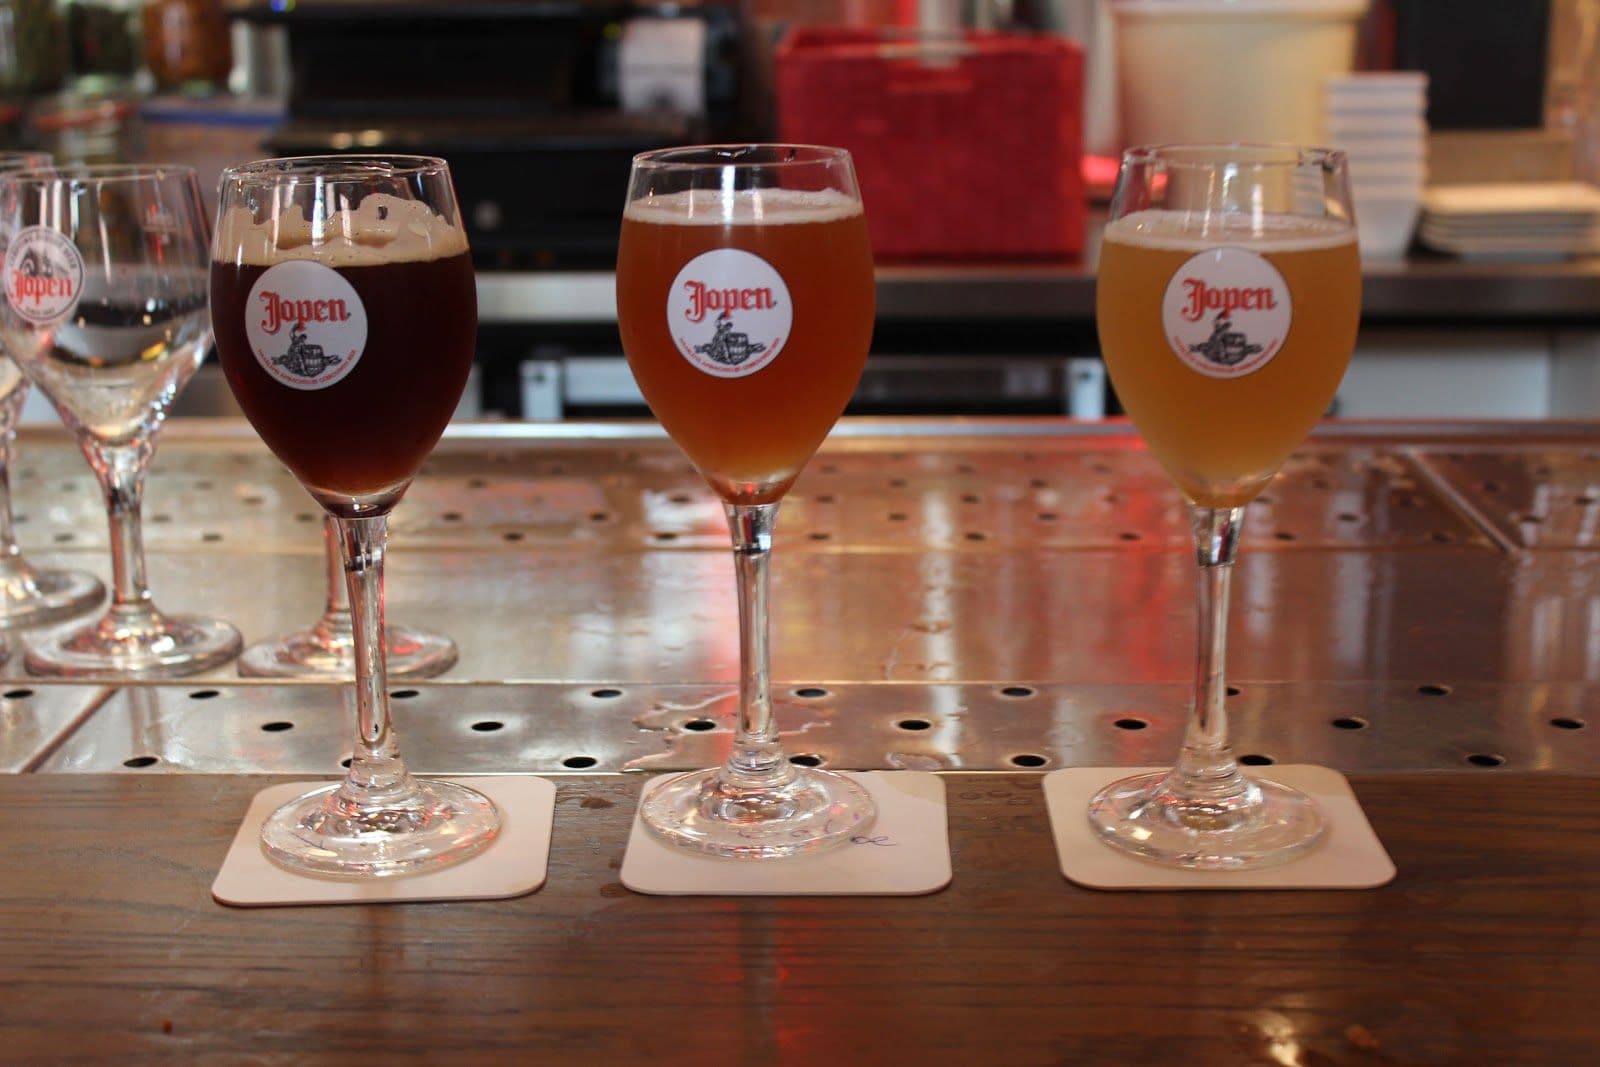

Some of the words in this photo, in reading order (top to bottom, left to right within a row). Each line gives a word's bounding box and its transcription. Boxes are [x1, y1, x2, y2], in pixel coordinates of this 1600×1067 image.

[10, 267, 73, 304] Jopen
[684, 280, 773, 324] Jopen
[1182, 277, 1274, 322] Jopen
[259, 290, 347, 335] Jopen
